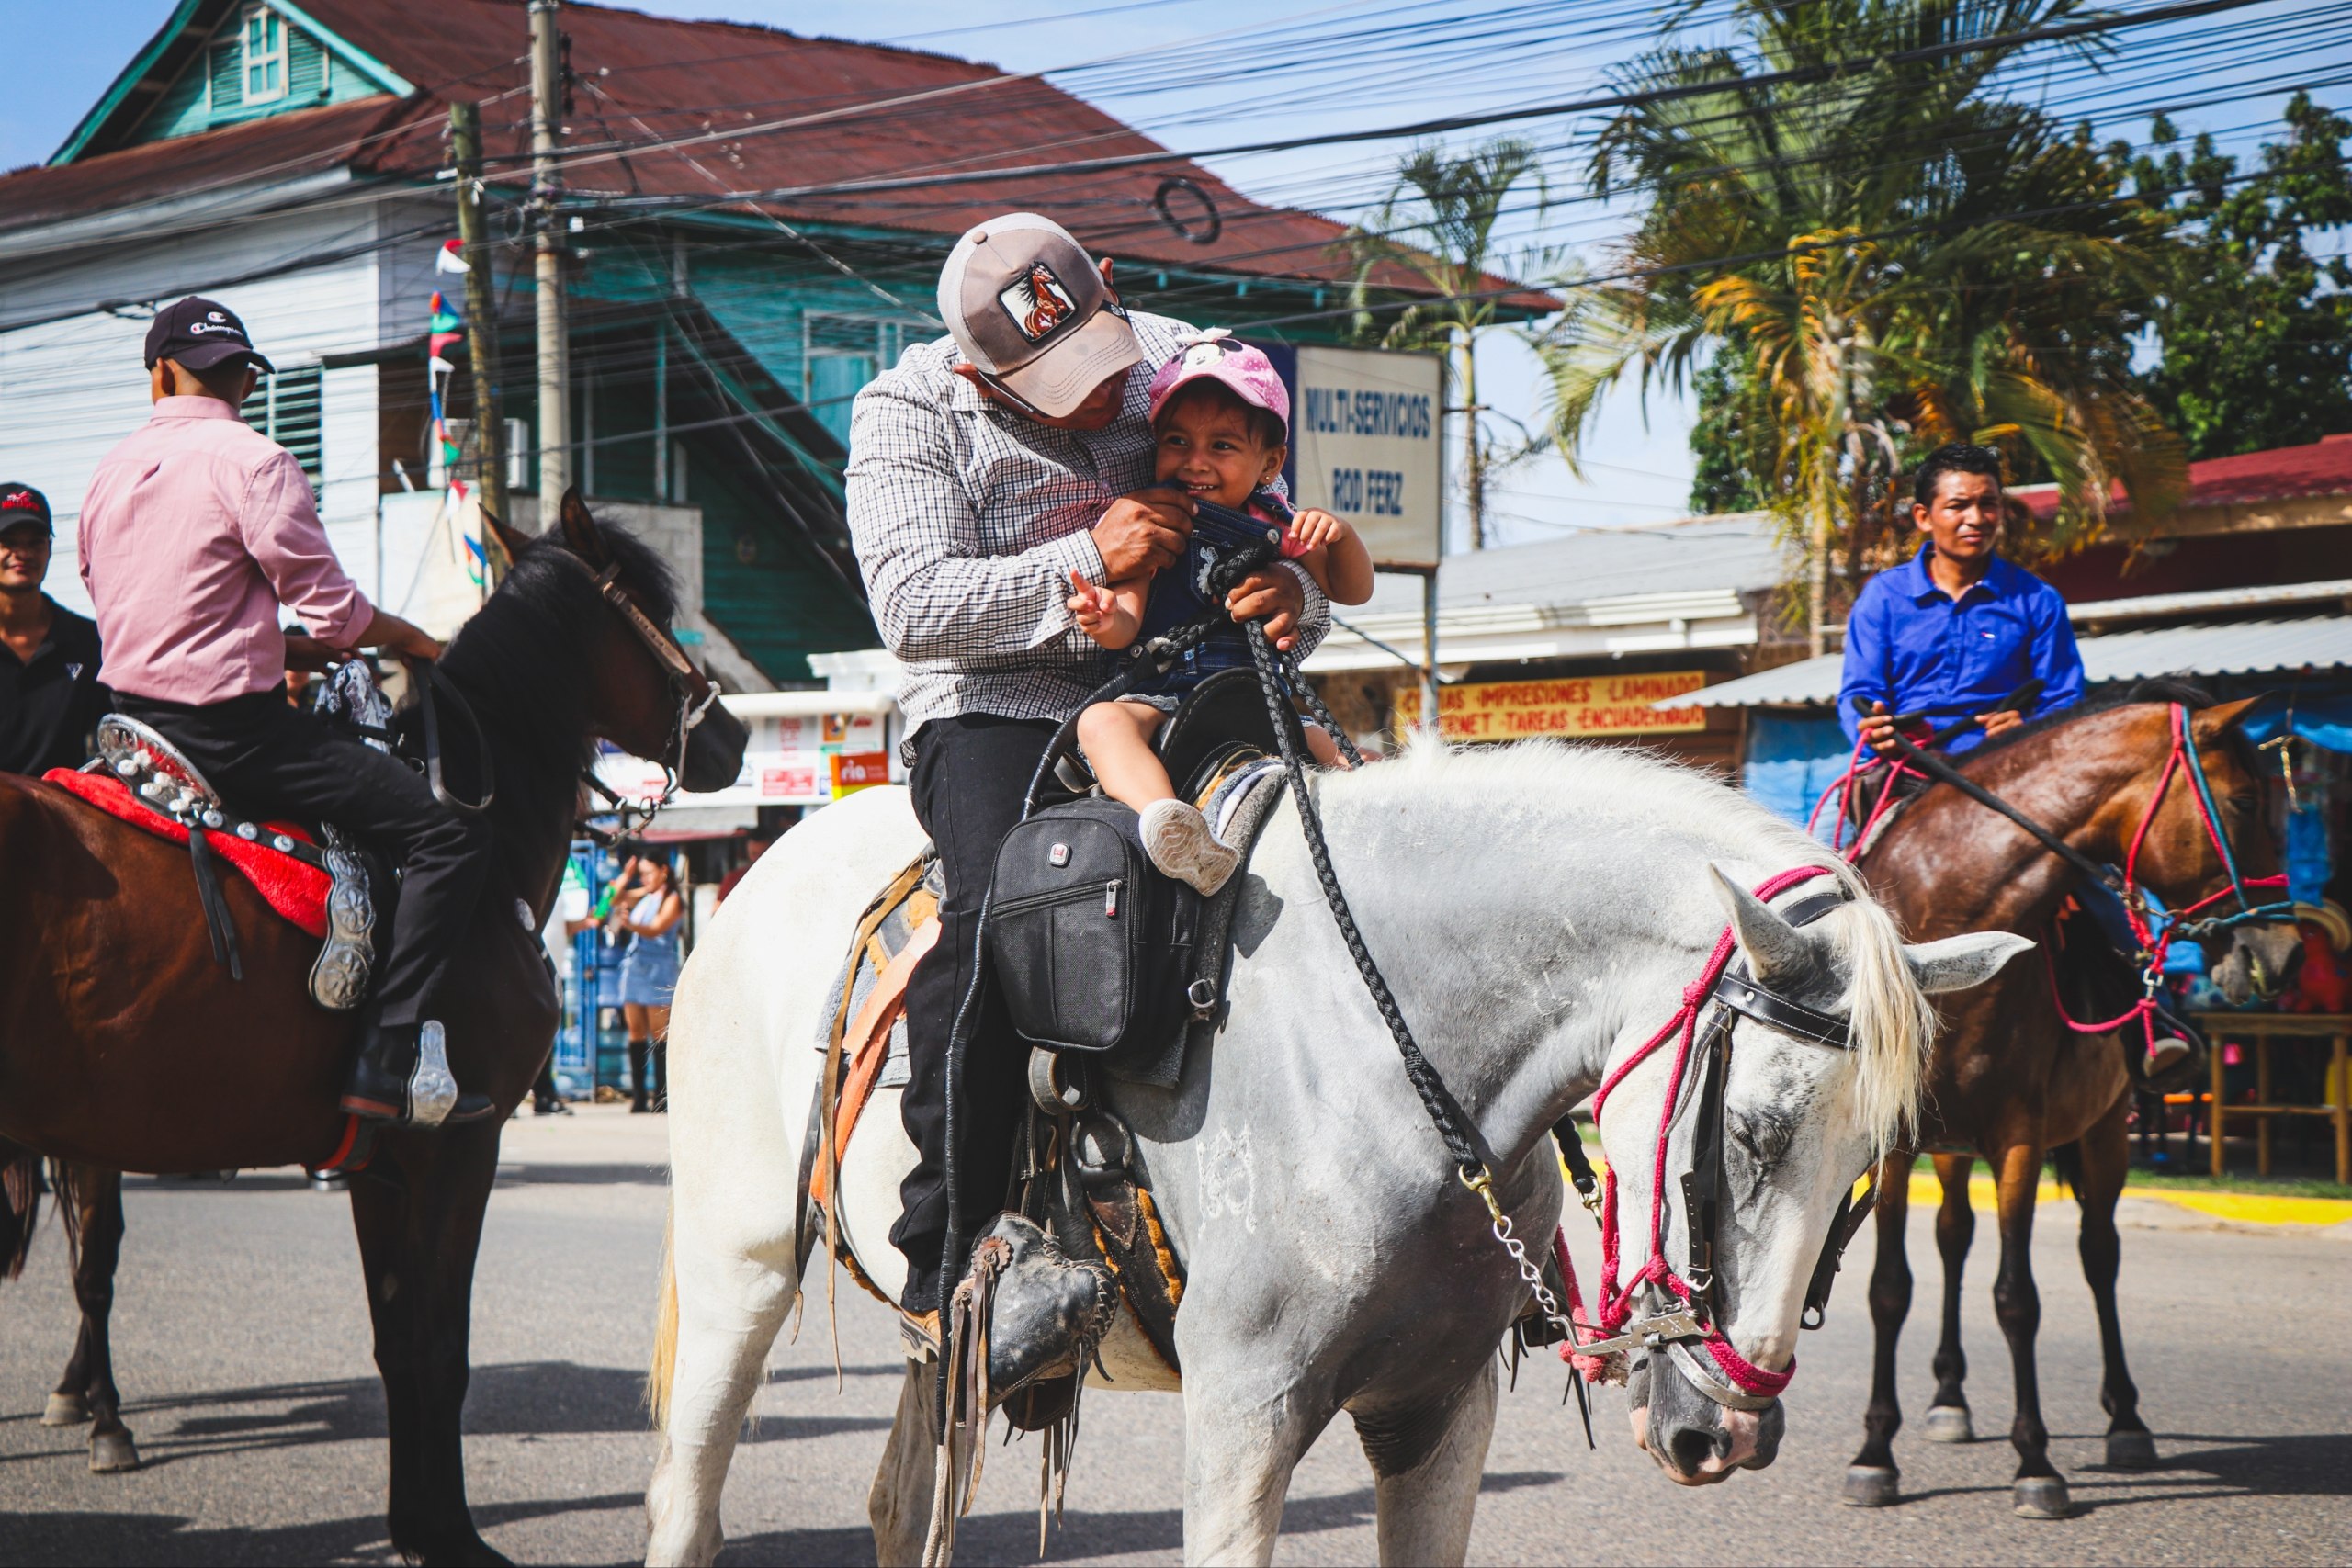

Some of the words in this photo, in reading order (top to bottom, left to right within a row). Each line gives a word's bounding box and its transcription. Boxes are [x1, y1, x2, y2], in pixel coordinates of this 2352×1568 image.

[1305, 387, 1430, 438] MULTI-SERVICIOS
[1333, 468, 1362, 512] ROD
[1366, 469, 1403, 515] FERZ
[1480, 680, 1591, 707] IMPRESIONES
[1505, 707, 1567, 733] TAREAS
